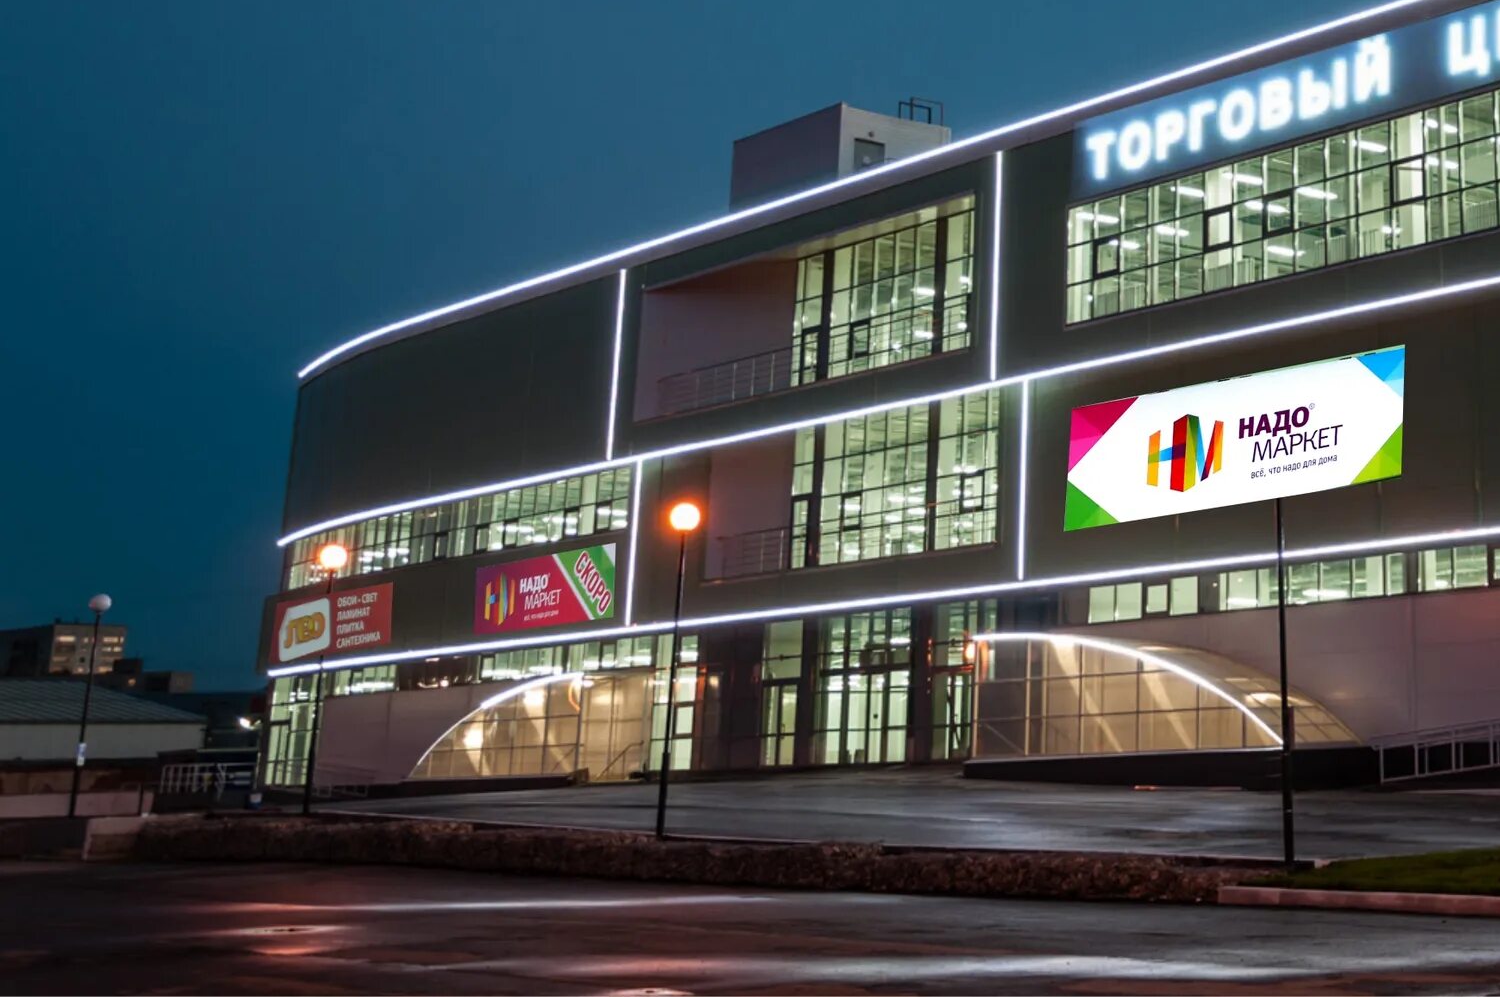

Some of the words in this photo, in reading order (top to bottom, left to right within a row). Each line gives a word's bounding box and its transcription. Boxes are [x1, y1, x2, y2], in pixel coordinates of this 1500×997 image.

[1085, 34, 1392, 180] ТОРГОВЫЙ
[1238, 405, 1310, 439] НАДО
[1251, 424, 1344, 463] МАРКЕТ
[1250, 467, 1267, 479] всё,
[1268, 465, 1281, 475] что
[1282, 461, 1302, 473] надо
[1302, 458, 1317, 469] для
[1317, 454, 1338, 466] дома
[519, 573, 549, 594] НАДО
[574, 550, 612, 616] СКОРО
[337, 595, 357, 607] ОБОИ
[361, 592, 378, 604] СВЕТ
[524, 589, 562, 610] МАРКЕТ
[336, 606, 371, 622] ЛАМИНАТ
[336, 630, 381, 649] САНТЕХНИКА
